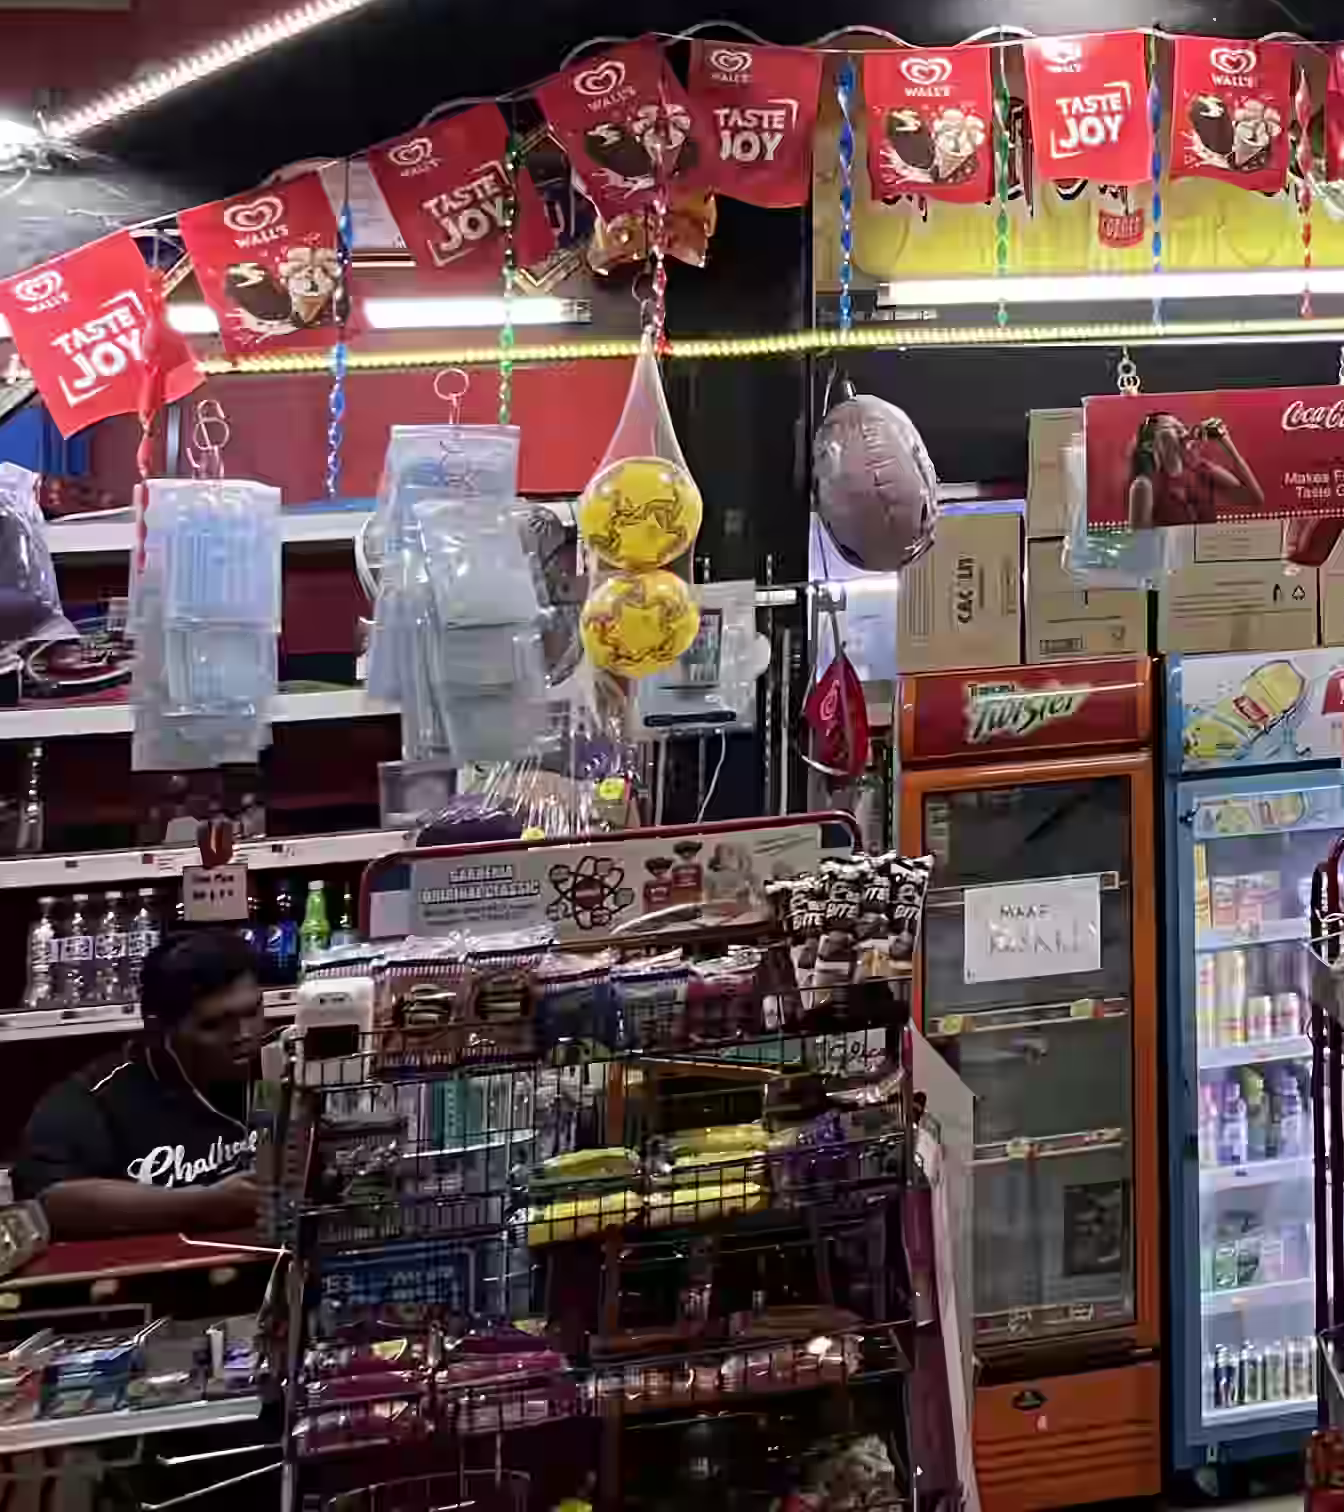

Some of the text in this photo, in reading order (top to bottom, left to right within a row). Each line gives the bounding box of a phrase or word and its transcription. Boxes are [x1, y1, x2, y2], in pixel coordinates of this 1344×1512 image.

[713, 108, 787, 130] TASTE
[1056, 92, 1122, 115] TASTE
[719, 132, 785, 162] JOY
[1059, 113, 1124, 150] JOY
[422, 173, 500, 218] TASTE
[439, 196, 505, 252] JOY
[51, 305, 136, 355] TASTE
[73, 328, 143, 389] JOY
